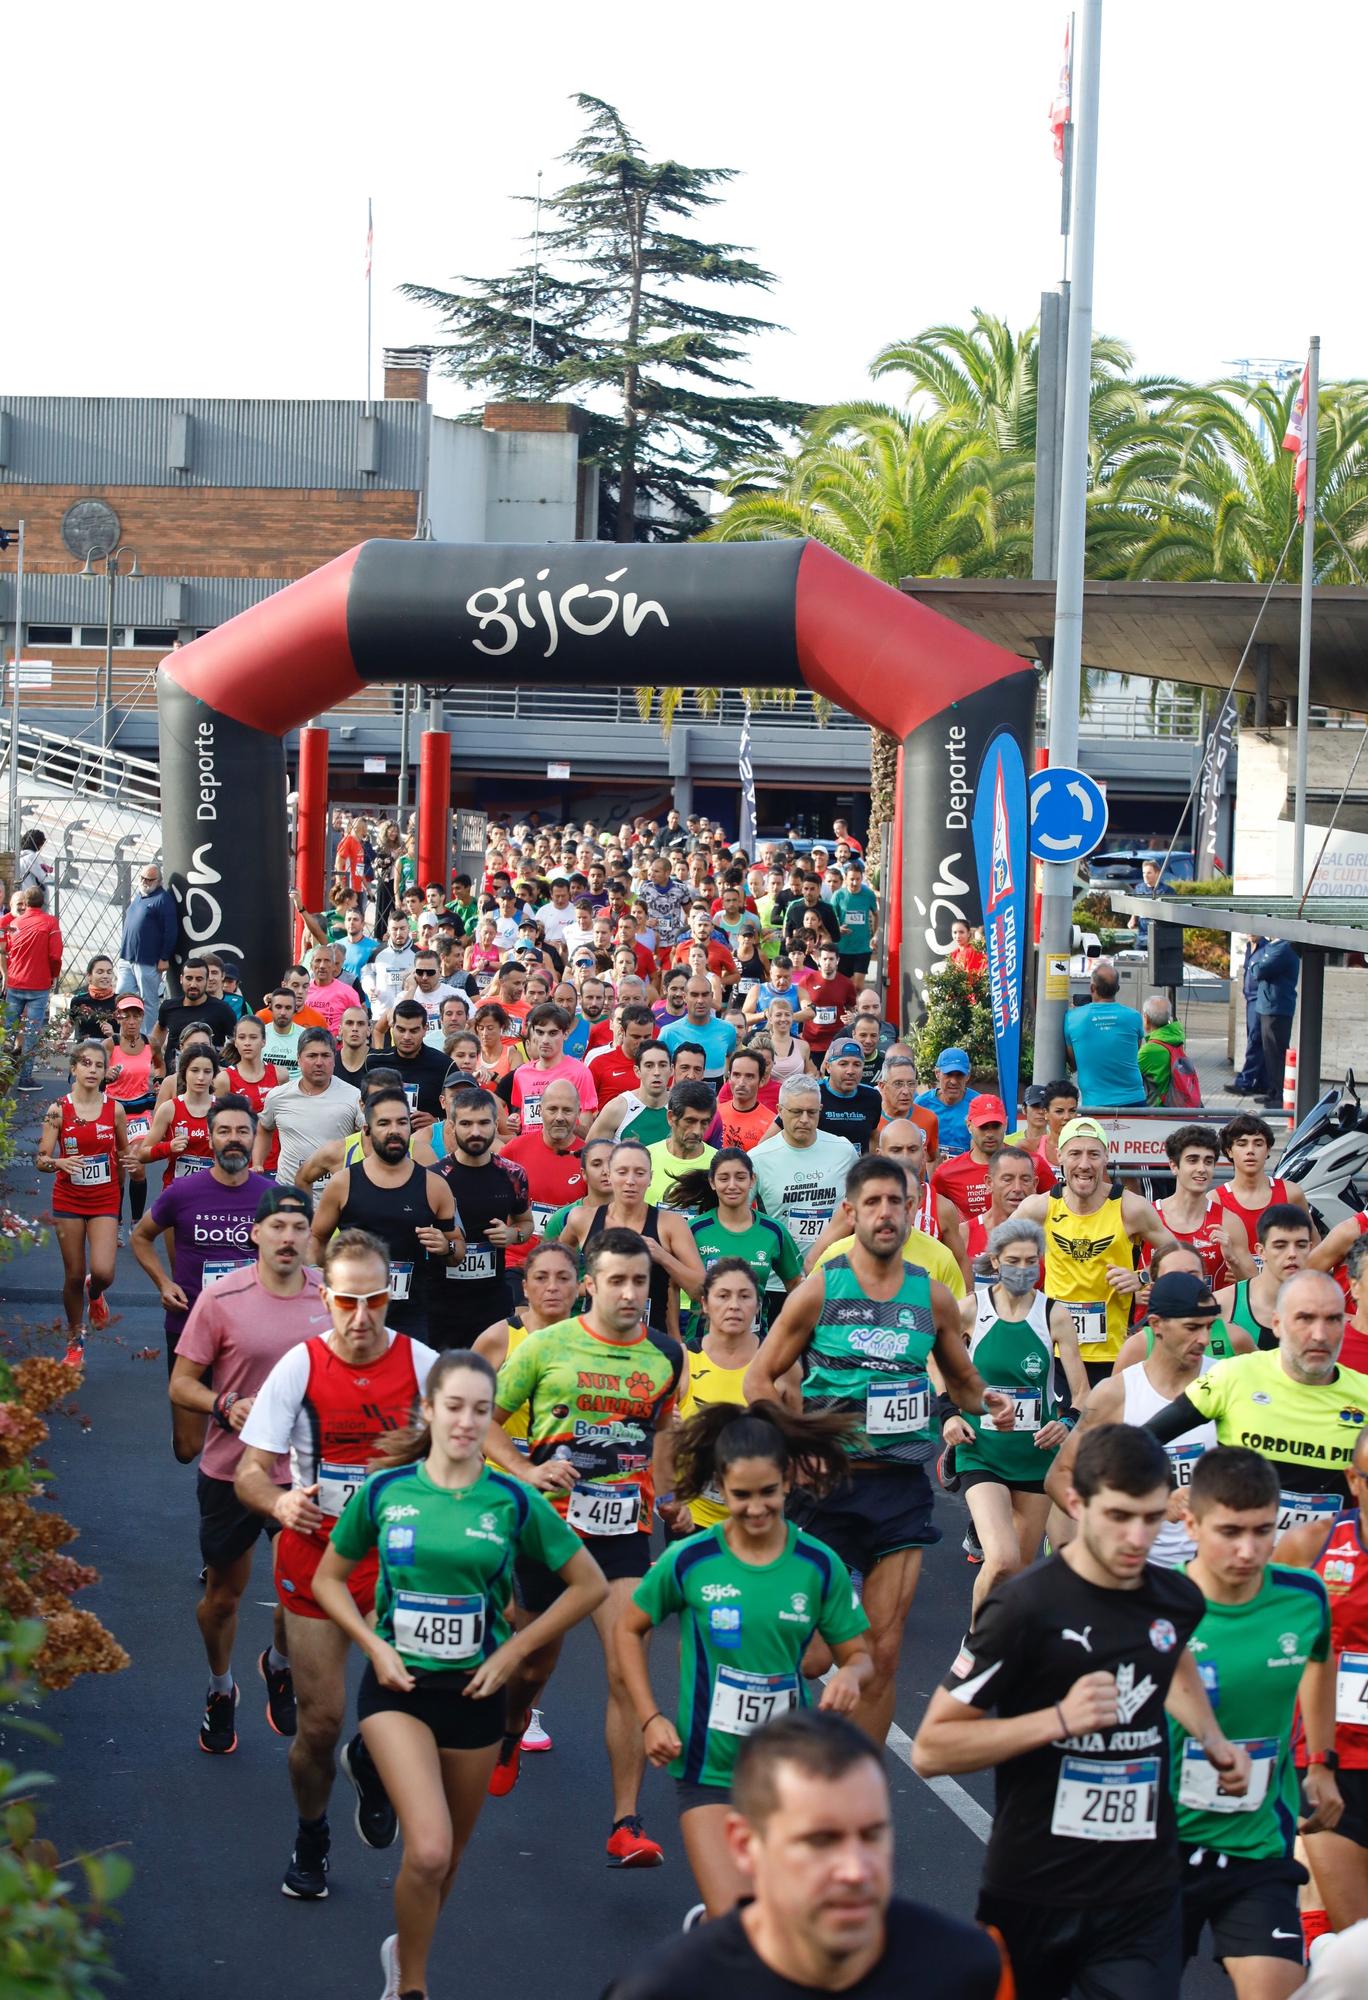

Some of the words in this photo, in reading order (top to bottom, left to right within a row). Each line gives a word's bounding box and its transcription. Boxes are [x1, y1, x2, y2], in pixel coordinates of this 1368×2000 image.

[466, 567, 670, 658] gijón
[195, 722, 222, 820] Deporte
[945, 726, 974, 829] Deporte
[744, 982, 757, 991] 33
[819, 1012, 831, 1021] 461
[81, 1165, 100, 1180] 120
[806, 1170, 824, 1180] edp
[782, 1187, 836, 1204] NOCTURNA
[790, 1183, 818, 1191] CARRERA
[800, 1220, 823, 1235] 287
[458, 1256, 485, 1272] 304
[577, 1371, 621, 1392] NUN
[884, 1397, 918, 1422] 450
[1241, 1432, 1326, 1460] CORDURA
[589, 1501, 622, 1524] 419
[414, 1616, 462, 1646] 489
[737, 1693, 776, 1724] 157
[1082, 1789, 1136, 1823] 268
